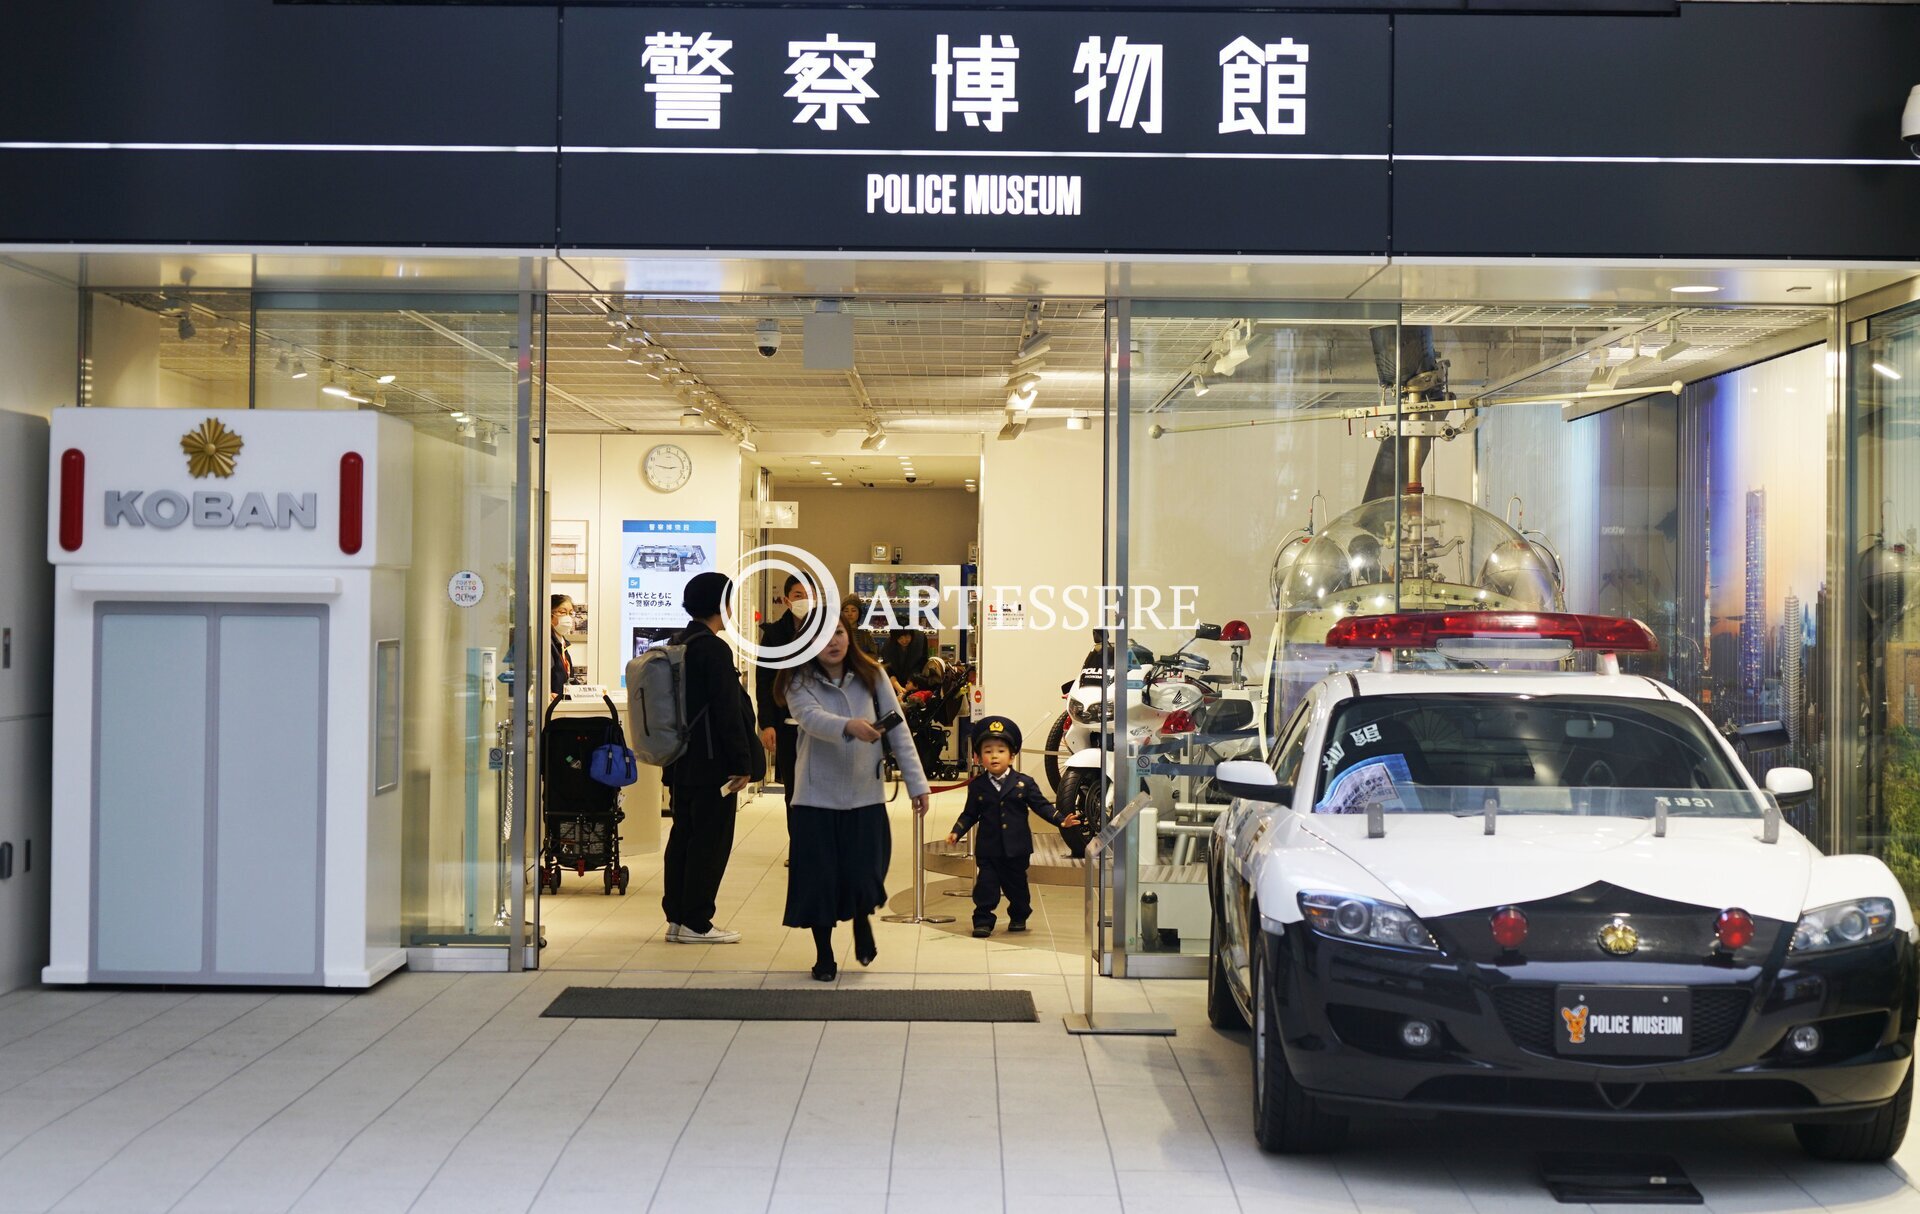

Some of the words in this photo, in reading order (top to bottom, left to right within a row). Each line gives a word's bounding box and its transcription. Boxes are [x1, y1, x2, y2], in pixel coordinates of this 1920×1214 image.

[641, 31, 1310, 135] 警察博物館
[866, 173, 957, 214] POLICE
[963, 174, 1082, 215] MUSEUM
[103, 490, 317, 530] KOBAN
[628, 591, 672, 600] 時代とともに
[1589, 1014, 1630, 1034] POLICE
[1631, 1015, 1683, 1035] MUSEUM
